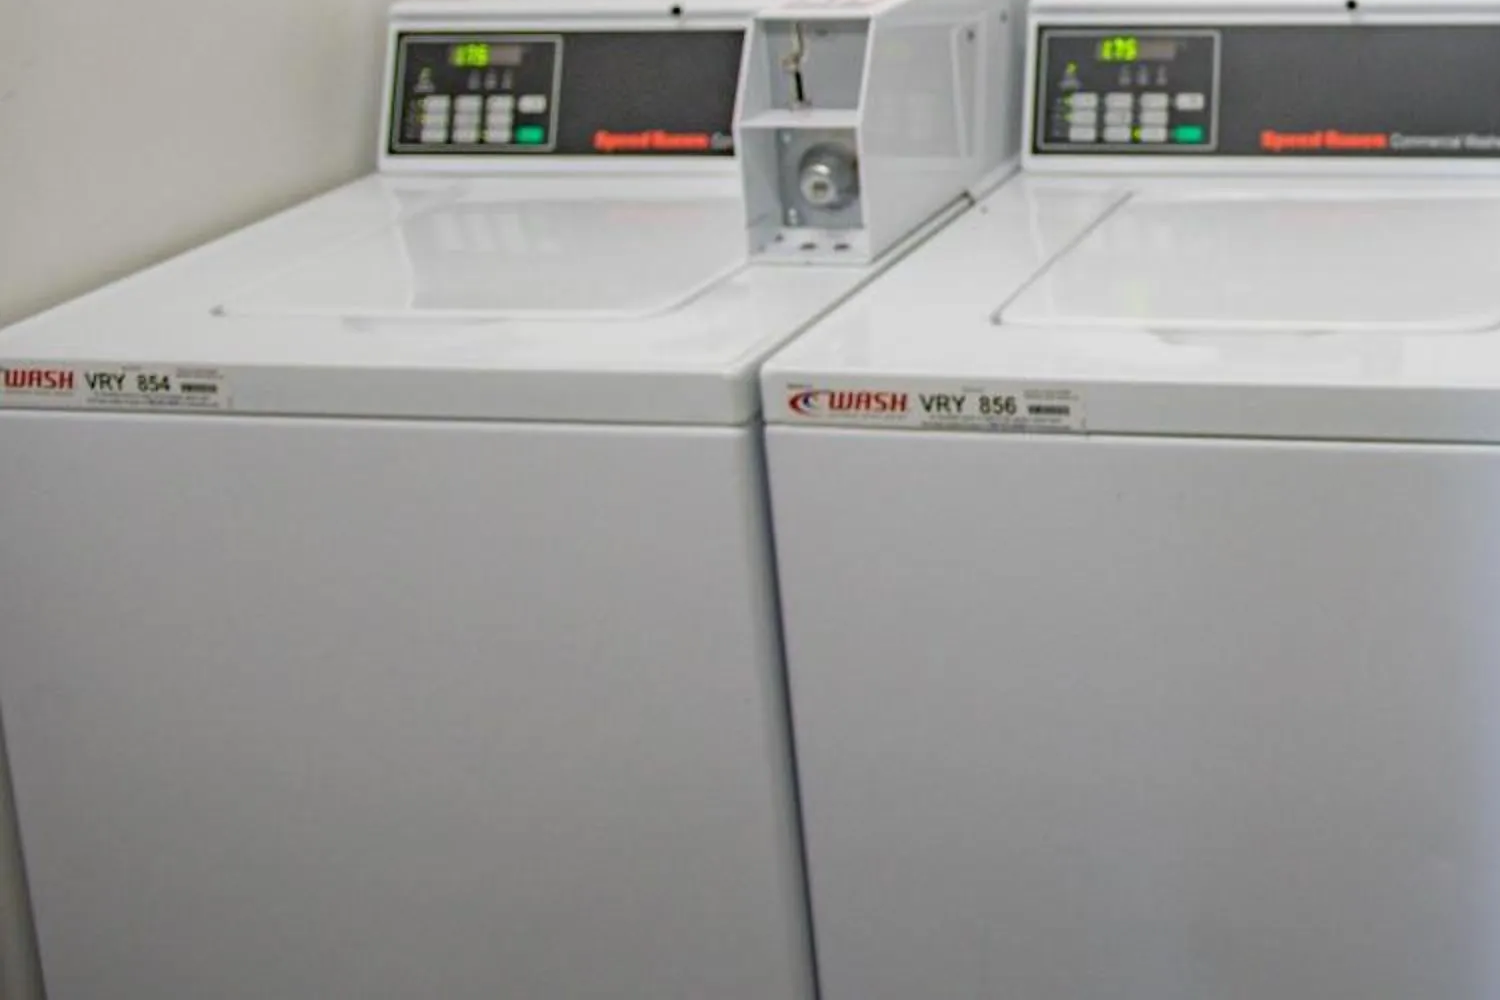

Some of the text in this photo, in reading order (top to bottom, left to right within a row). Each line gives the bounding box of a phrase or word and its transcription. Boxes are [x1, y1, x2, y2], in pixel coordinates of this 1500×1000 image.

[4, 368, 171, 393] WASH VRY 854
[828, 390, 908, 413] WASH
[918, 392, 967, 414] VRY
[978, 395, 1018, 417] 856
